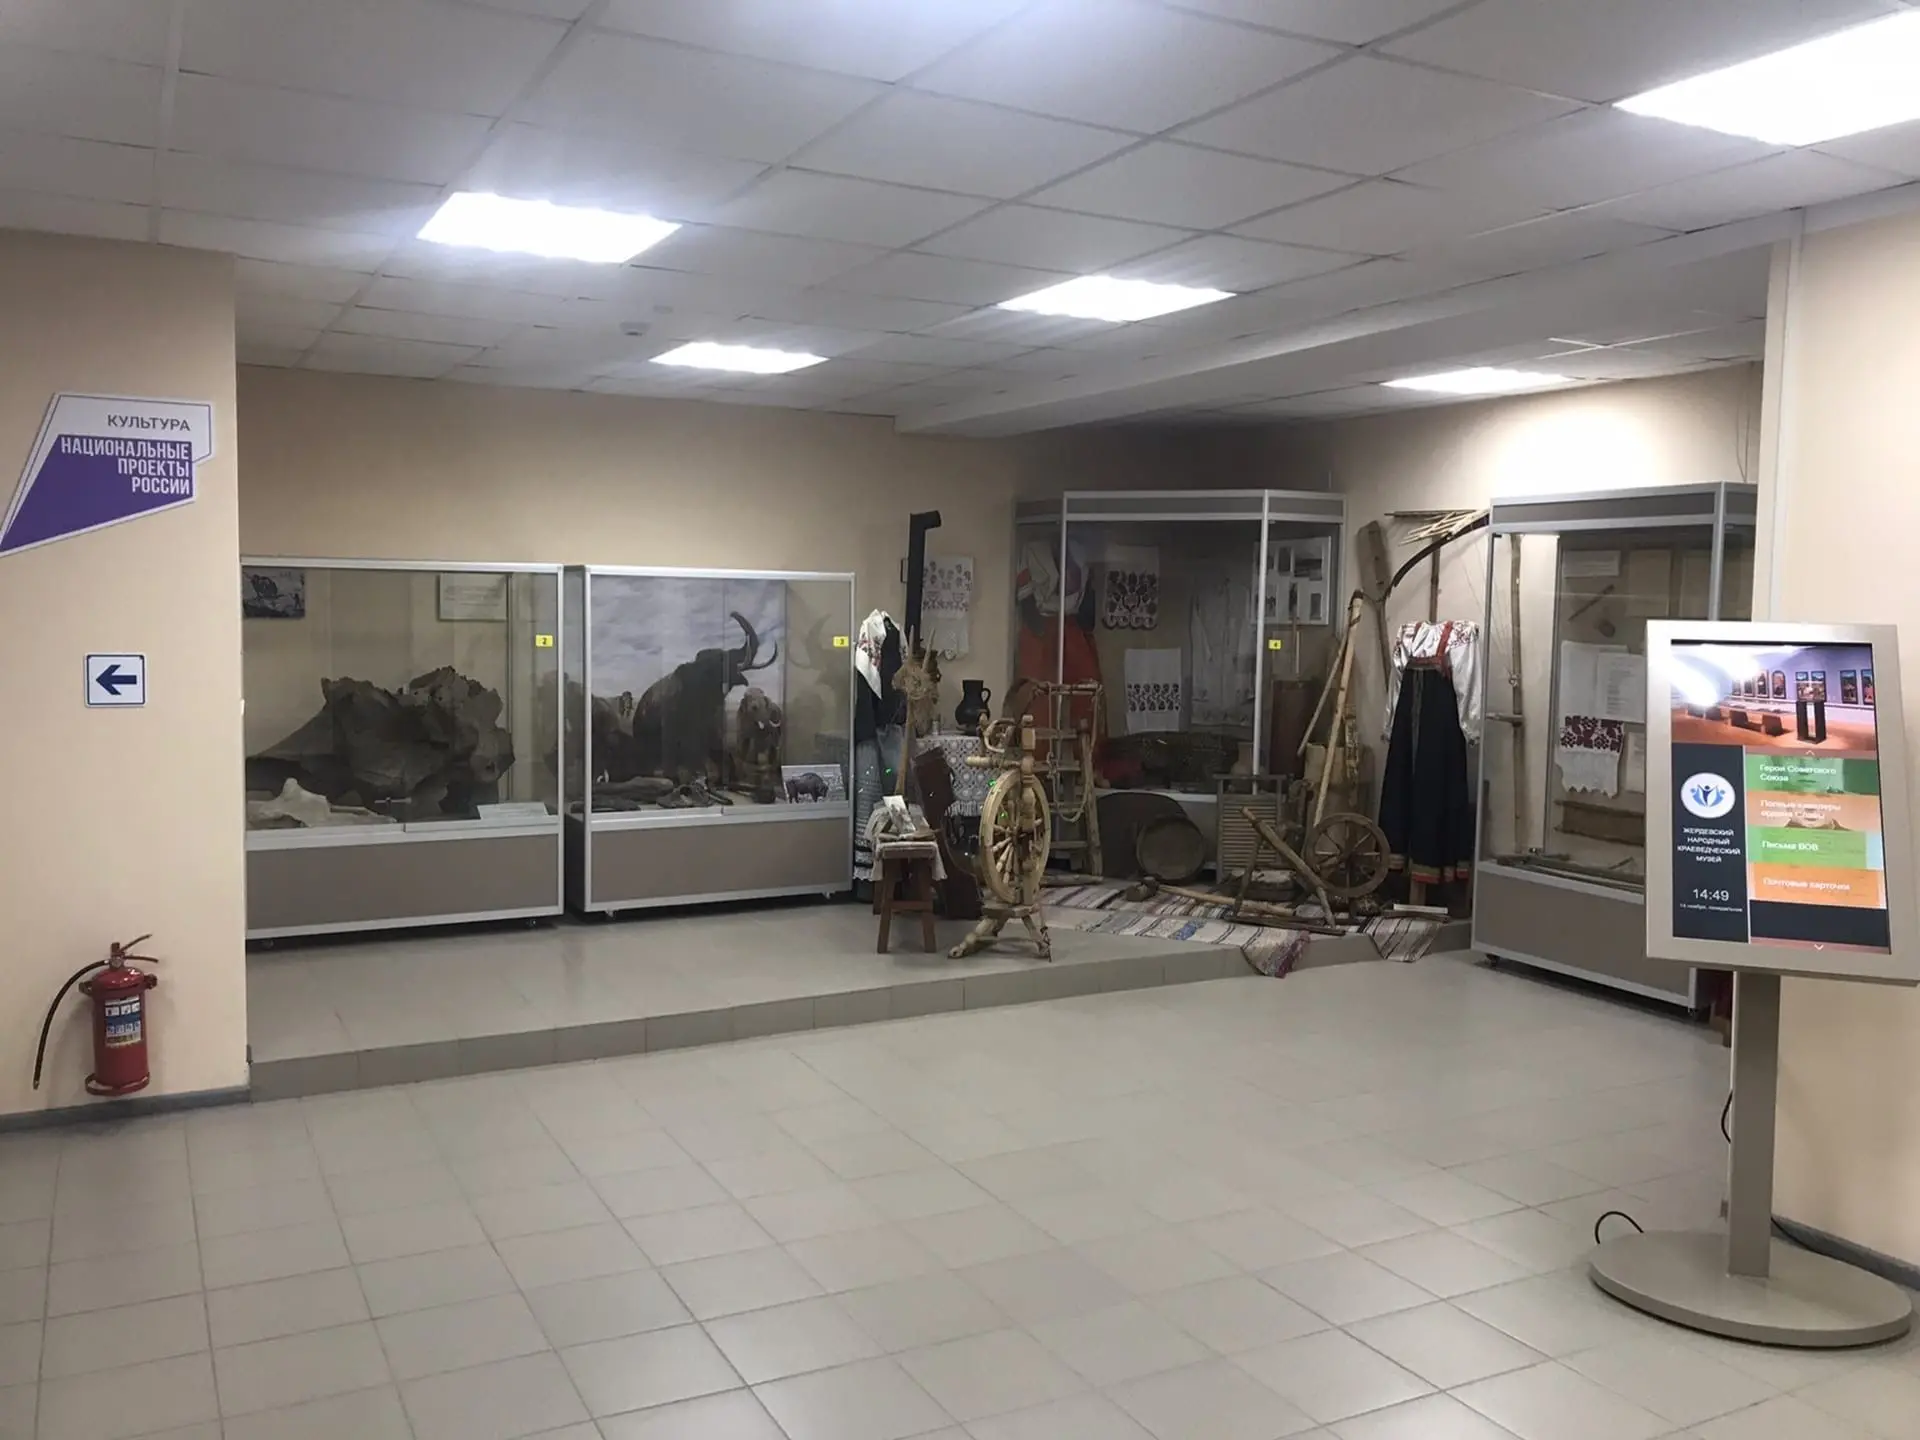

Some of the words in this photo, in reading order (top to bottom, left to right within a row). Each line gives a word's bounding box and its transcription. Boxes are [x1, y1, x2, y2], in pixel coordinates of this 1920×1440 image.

[107, 414, 191, 432] КУЛЬТУРА
[61, 436, 190, 460] НАЦИОНАЛЬНЫЕ
[117, 458, 190, 478] ПРОЕКТЫ
[131, 476, 190, 495] РОССИИ
[1760, 763, 1786, 773] Герои
[1787, 764, 1837, 775] Советского
[1760, 772, 1789, 782] Союза
[1687, 836, 1731, 846] НАРОДНЫЙ
[1761, 840, 1797, 850] Письма
[1798, 842, 1819, 852] ВОВ
[1677, 845, 1741, 856] КРАЕВЕДЧЕСКИЙ
[1695, 855, 1722, 863] МУЗЕЙ
[1692, 888, 1730, 902] 14:49
